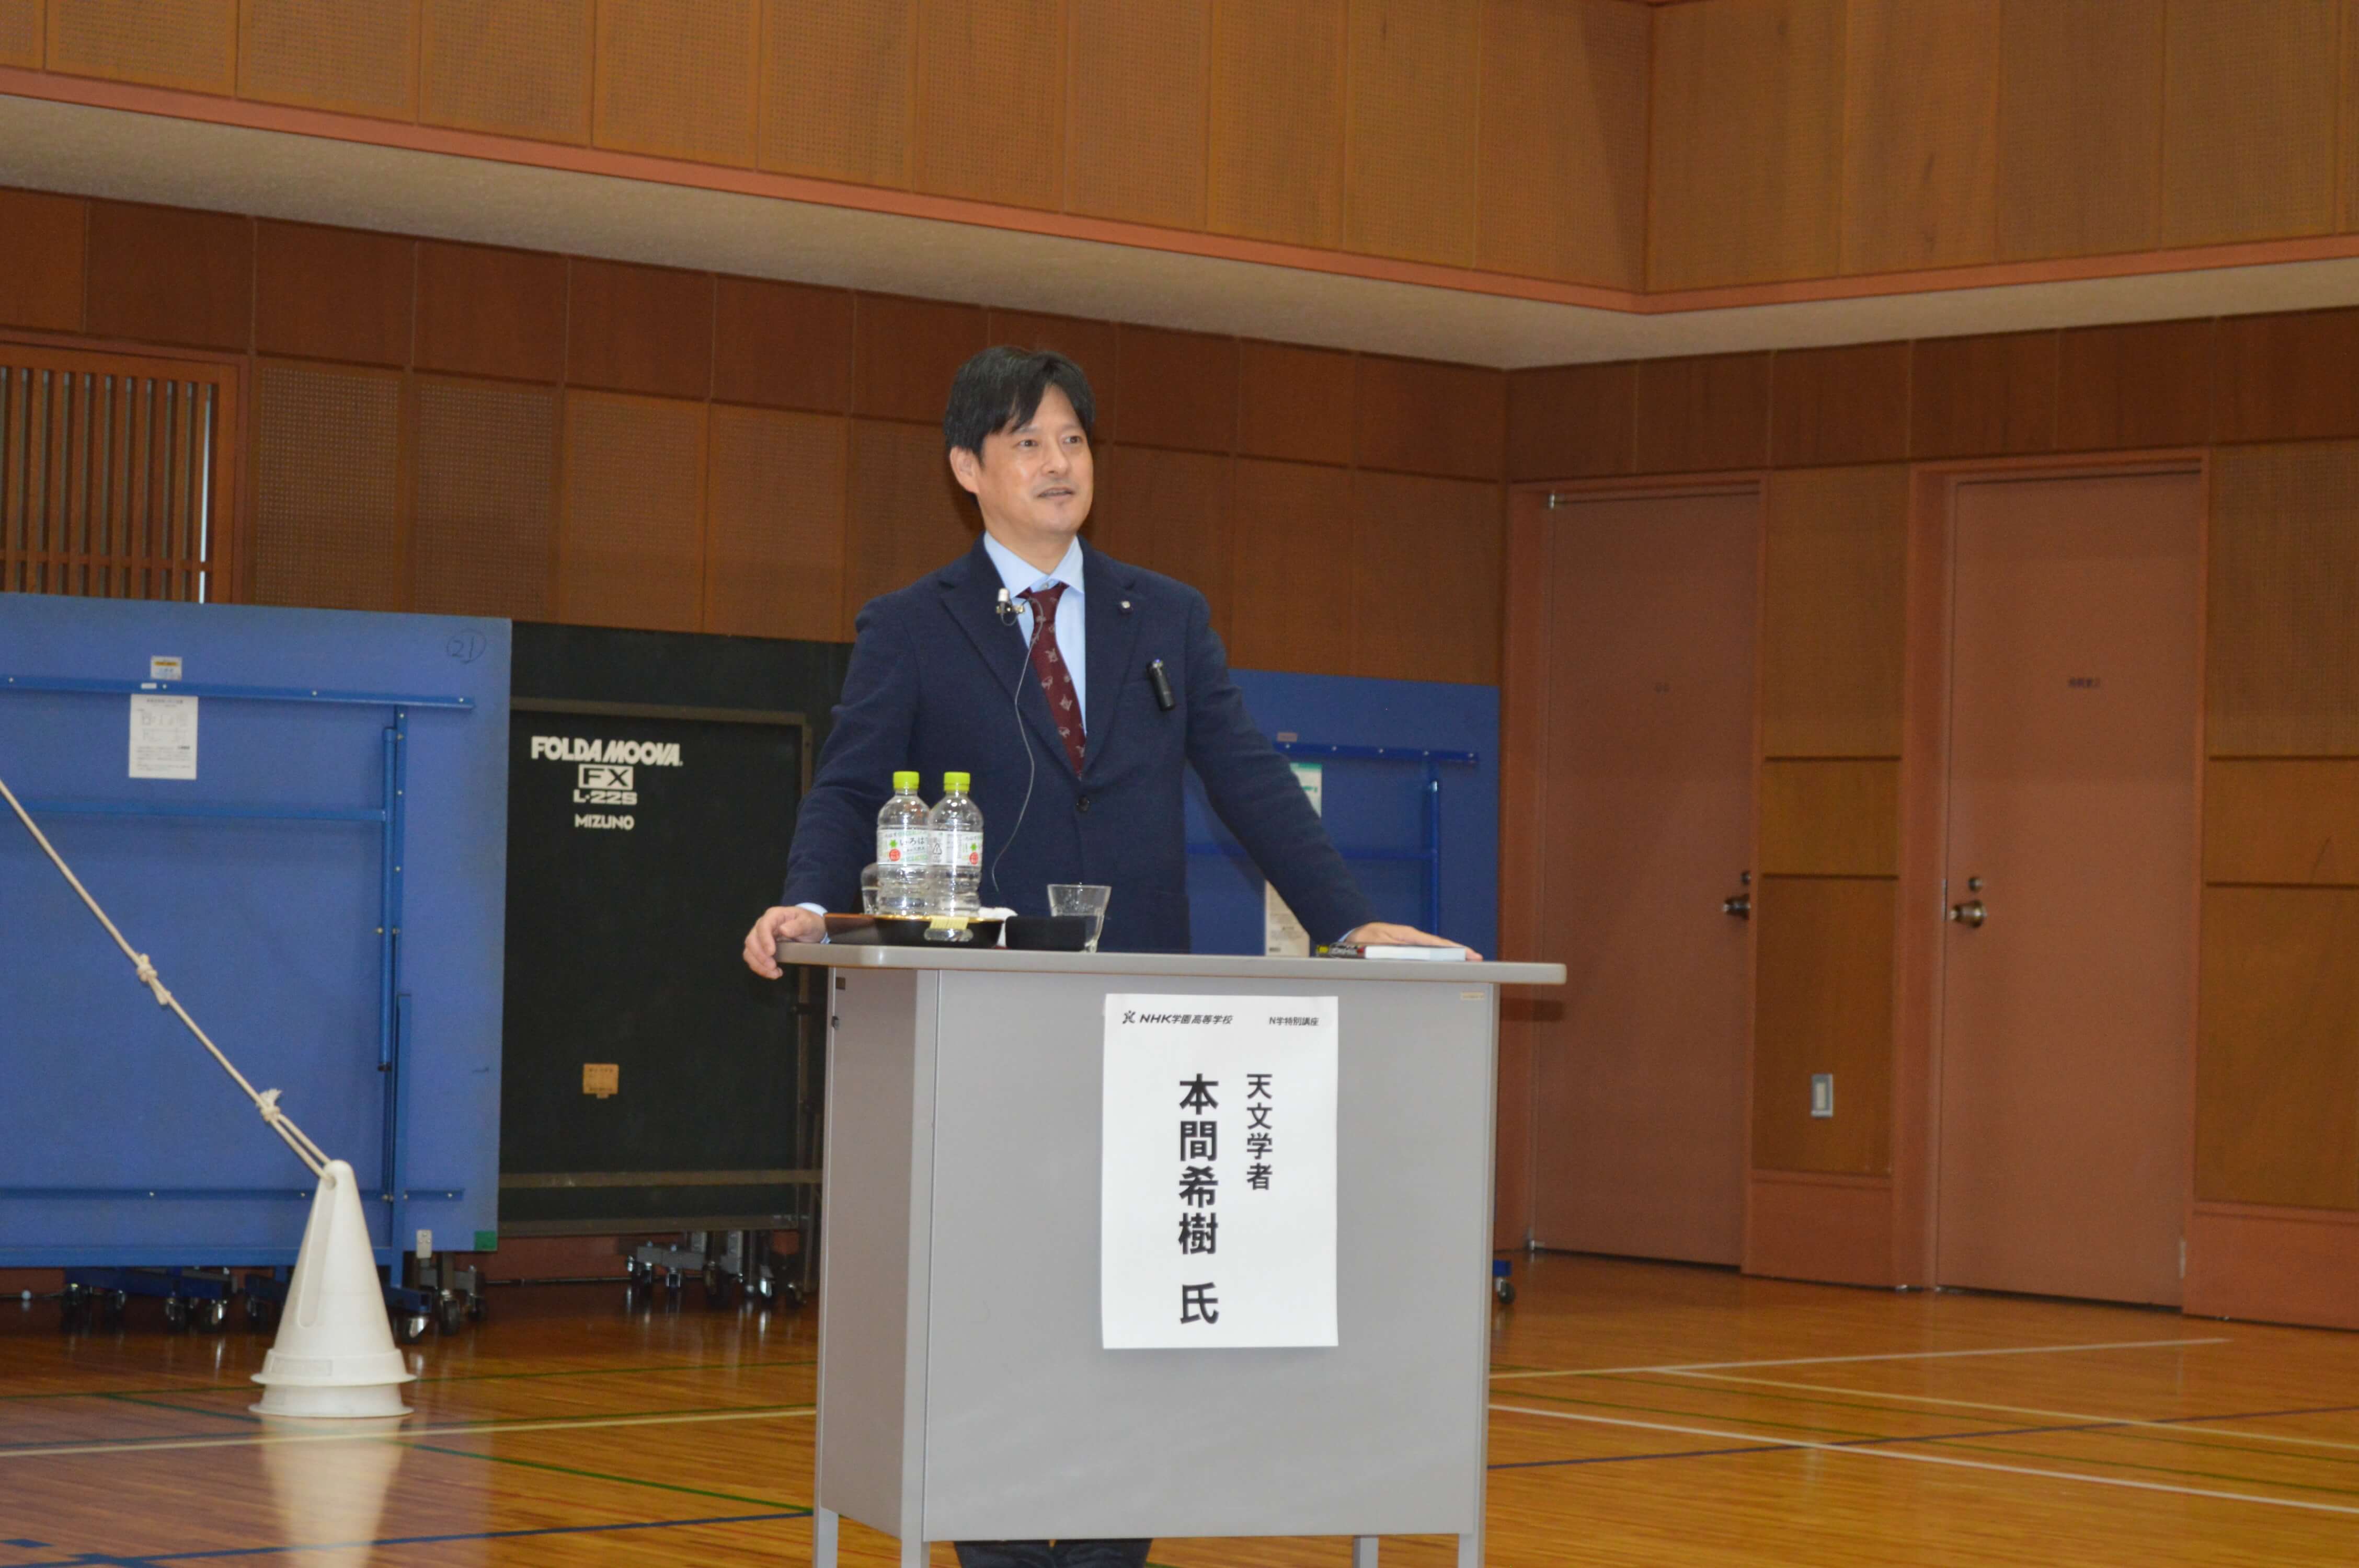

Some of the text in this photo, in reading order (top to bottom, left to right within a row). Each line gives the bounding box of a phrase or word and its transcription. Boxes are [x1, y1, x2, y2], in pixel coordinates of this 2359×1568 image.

[531, 735, 602, 763] FOLDA
[582, 767, 629, 787] FX
[575, 813, 635, 831] MIZUNO
[1246, 1073, 1273, 1191] 天文学者
[1178, 1073, 1219, 1324] 本間希樹 氏
